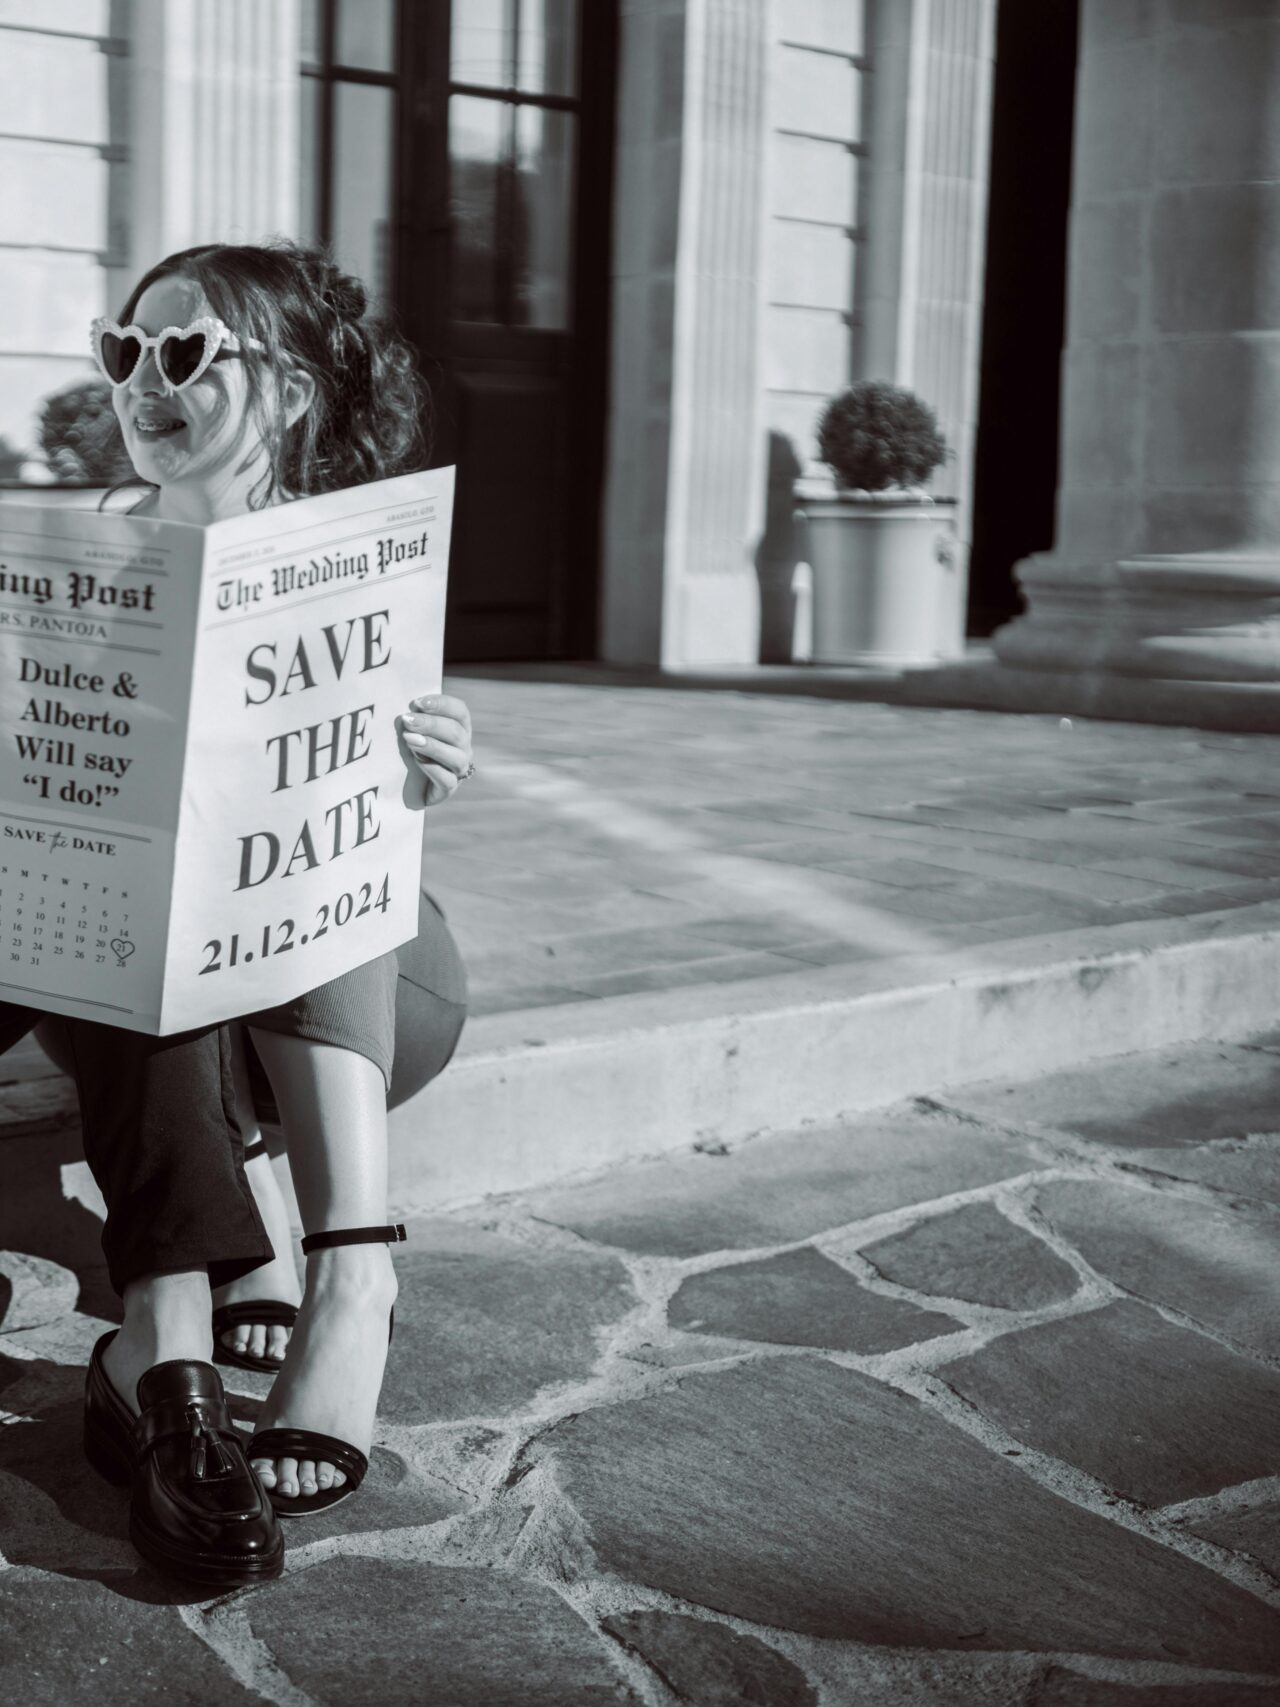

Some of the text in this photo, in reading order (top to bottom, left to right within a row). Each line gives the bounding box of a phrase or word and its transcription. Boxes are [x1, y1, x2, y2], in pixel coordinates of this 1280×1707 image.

[67, 571, 155, 611] Post
[217, 577, 263, 612] The
[272, 552, 369, 598] Wedding
[376, 532, 429, 574] Post
[30, 615, 107, 638] PANTOJA
[18, 657, 139, 699] Dulce &
[245, 609, 392, 709] SAVE
[19, 697, 131, 737] Alberto
[15, 734, 133, 779] Will say
[266, 704, 375, 793] THE
[4, 825, 116, 856] SAVE the DATE
[232, 786, 381, 892] DATE
[83, 882, 90, 890] T
[17, 908, 22, 916] 9
[36, 912, 45, 920] 10
[57, 916, 65, 924] 11
[78, 920, 87, 928] 12
[99, 924, 108, 933] 13
[120, 929, 129, 937] 14
[19, 893, 24, 901] 2
[40, 897, 45, 905] 3
[60, 901, 66, 909] 4
[81, 905, 87, 913] 5
[102, 910, 108, 918] 6
[124, 914, 129, 922] 7
[198, 872, 391, 976] 21.12.2024
[12, 938, 22, 947] 23
[33, 942, 42, 951] 24
[54, 946, 64, 954] 25
[75, 950, 84, 959] 26
[96, 954, 105, 963] 27
[116, 959, 126, 968] 28
[13, 923, 22, 931] 16
[34, 927, 43, 935] 17
[55, 931, 63, 939] 18
[76, 935, 85, 943] 19
[96, 939, 106, 948] 20
[117, 943, 125, 952] 21
[10, 953, 20, 961] 30
[31, 957, 39, 966] 31
